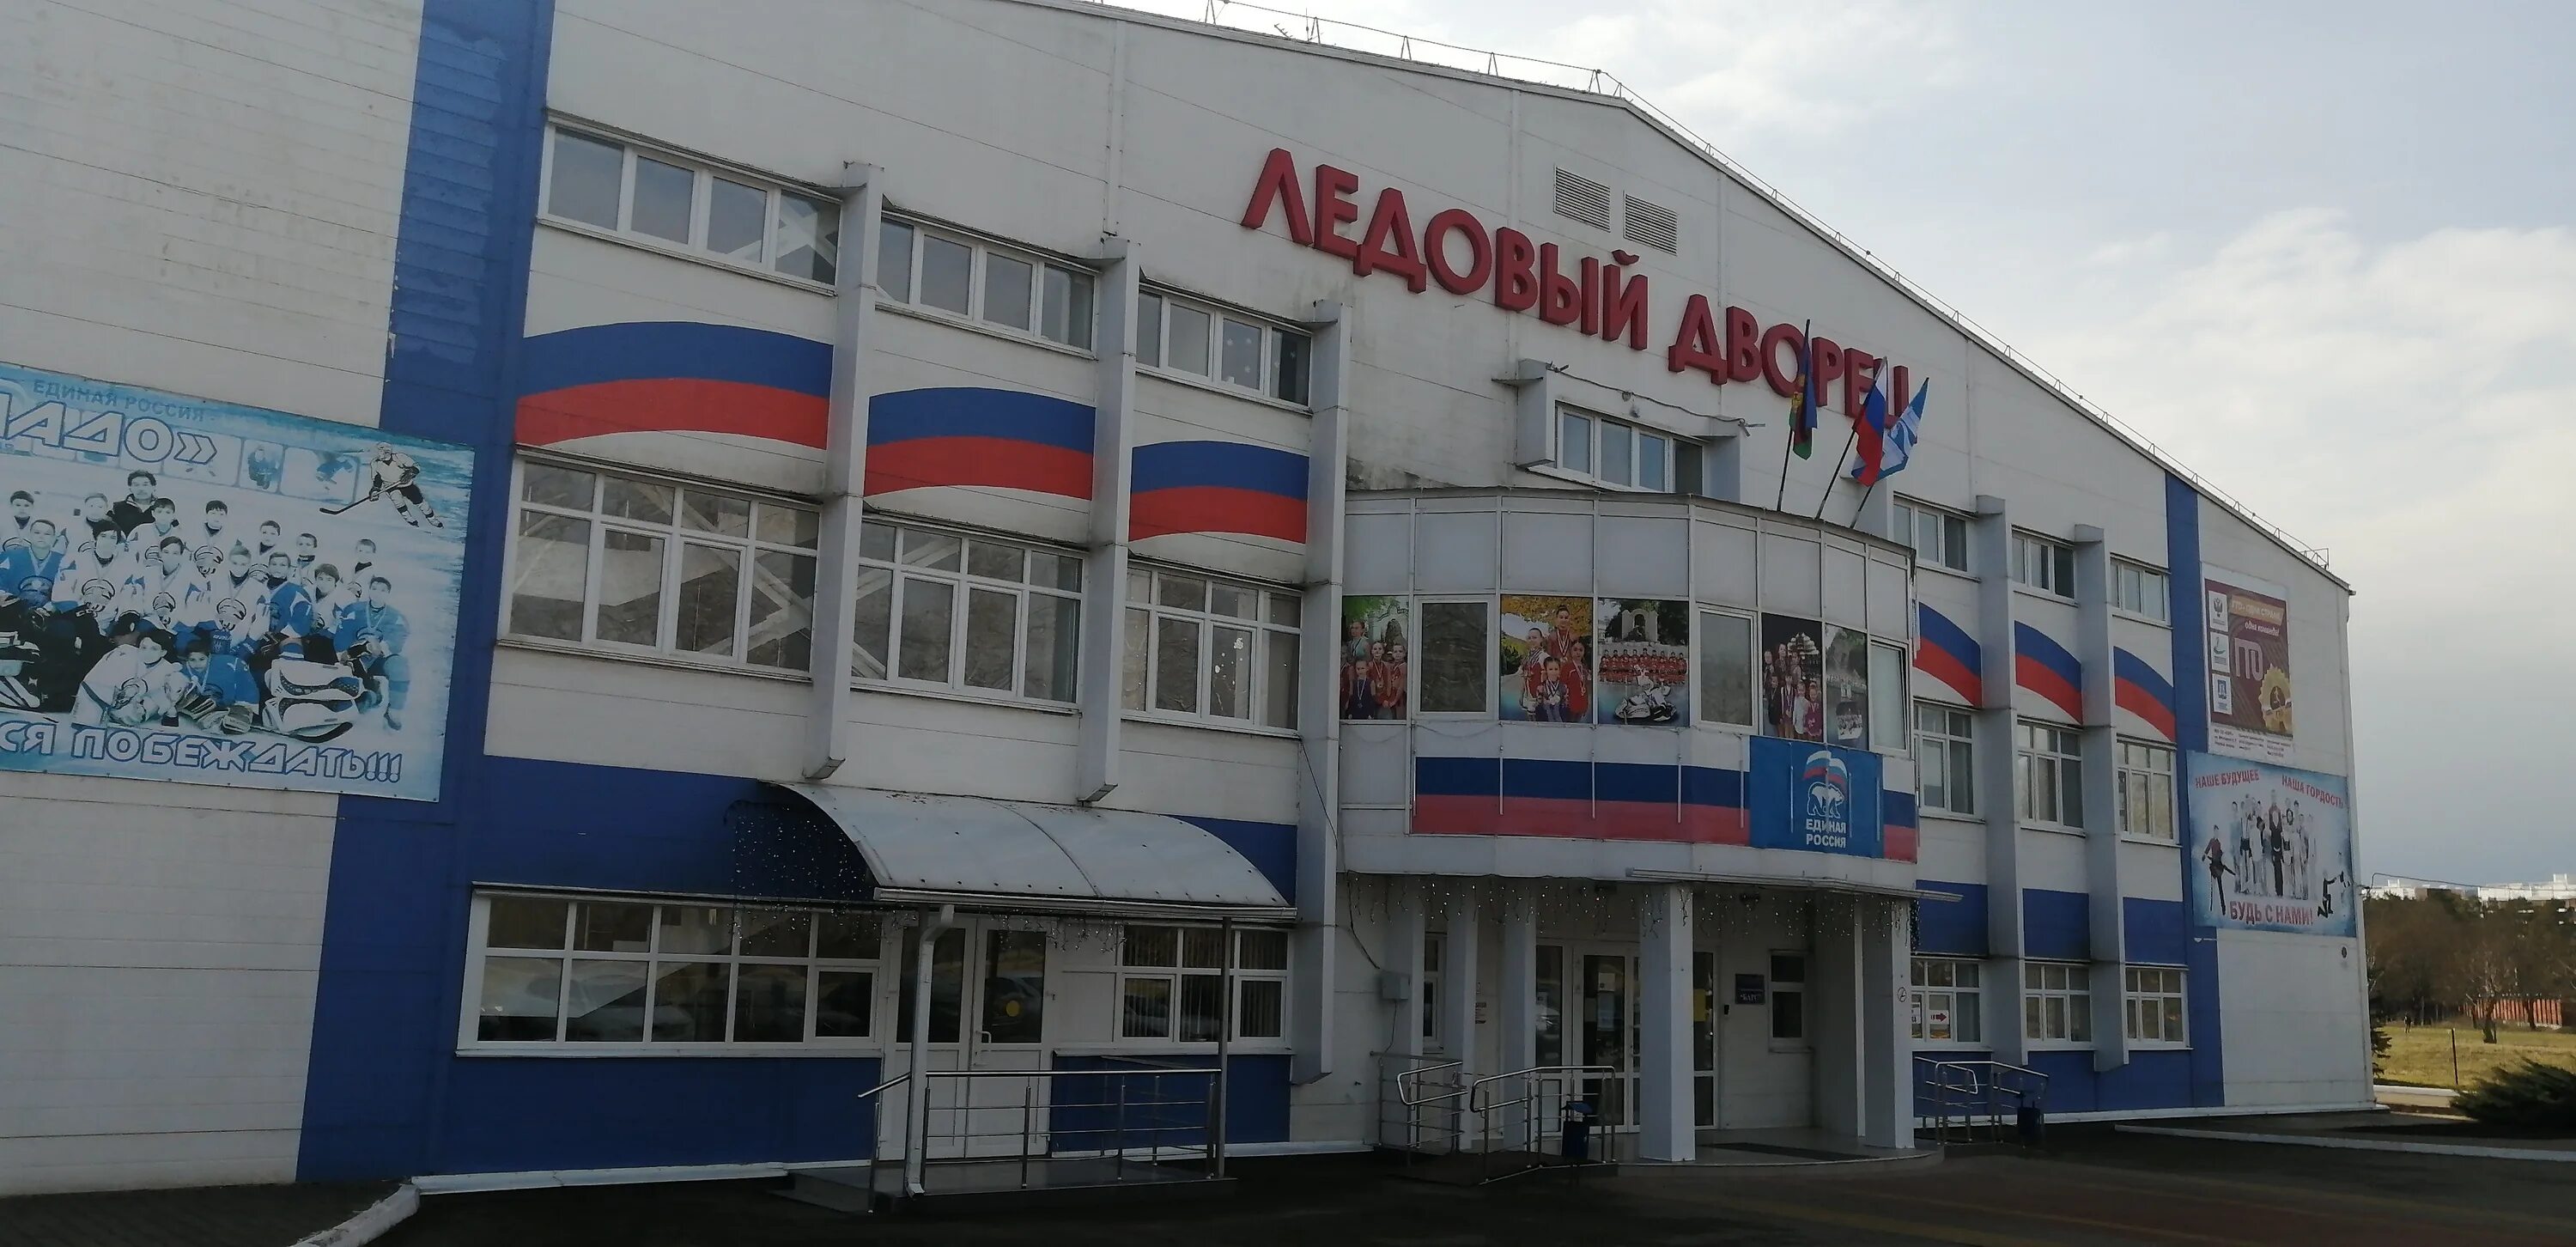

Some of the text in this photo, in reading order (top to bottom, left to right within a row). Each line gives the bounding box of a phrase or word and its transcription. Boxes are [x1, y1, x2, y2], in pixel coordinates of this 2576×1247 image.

[1241, 147, 1648, 351] ЛЕДОВЫЙ
[33, 379, 206, 423] ЕДИНАЯ РОССИЯ
[0, 391, 218, 465] АДО»
[71, 723, 403, 783] ПОБЕЖДАТЬ!!!
[2195, 769, 2260, 788] НАШЕ БУДУЩЕЕ
[2281, 775, 2343, 808] НАША ГОРДОСТЬ
[1806, 818, 1846, 834] ЕДИНАЯ
[1806, 833, 1846, 849] РОССИЯ
[2230, 900, 2313, 926] БУДЬ С НАМИ!
